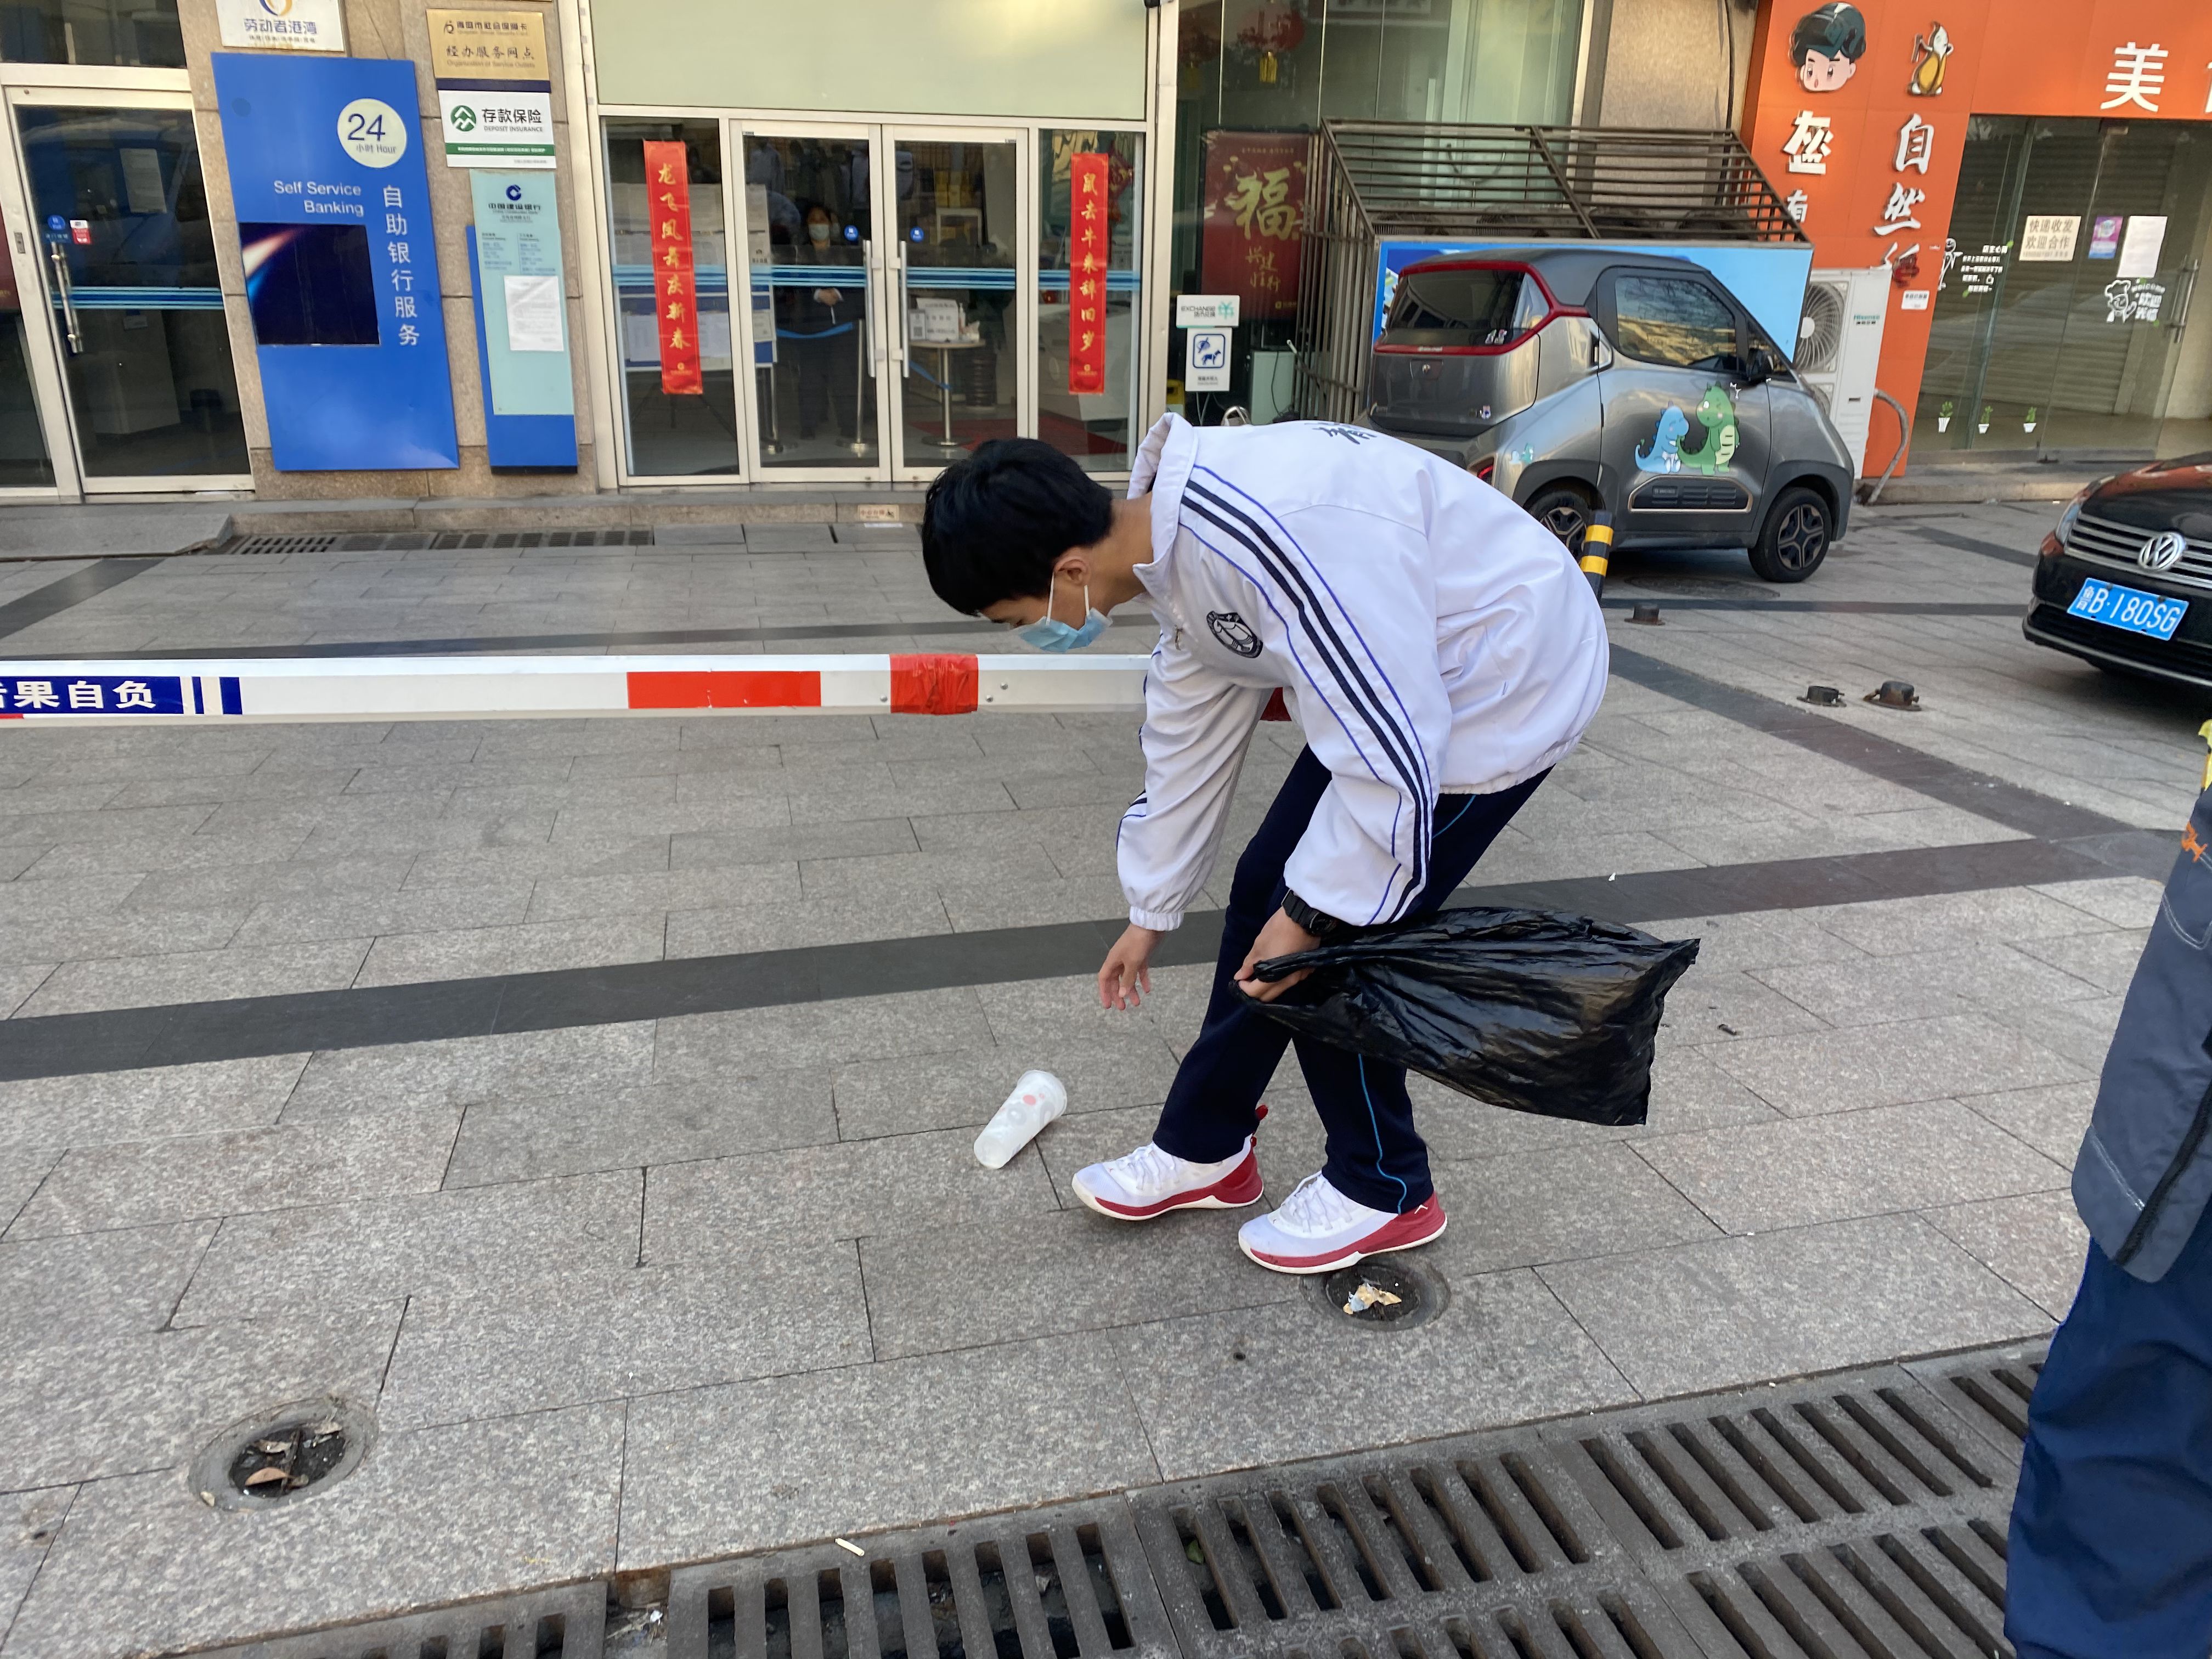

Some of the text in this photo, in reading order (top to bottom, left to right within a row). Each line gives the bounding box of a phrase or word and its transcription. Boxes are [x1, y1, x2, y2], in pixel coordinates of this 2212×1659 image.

[244, 19, 317, 34] 劳动者港湾
[446, 46, 534, 61] 经办服务网点
[2100, 41, 2212, 113] 美
[482, 108, 542, 124] 存款保险
[347, 113, 386, 142] 24
[356, 144, 397, 154] 小时 Hour
[274, 180, 362, 196] Self Service
[304, 200, 364, 218] Banking
[1229, 167, 1297, 240] 福
[2029, 219, 2073, 233] 快递收发
[2025, 236, 2070, 250] 欢迎合作
[658, 163, 691, 350] 龙飞凤舞庆新春
[1080, 172, 1099, 352] 鼠去牛来辞旧岁
[383, 185, 420, 346] 自助银行服务
[2138, 292, 2162, 307] 欢迎
[2135, 307, 2159, 321] 光临
[0, 680, 156, 709] 果自负
